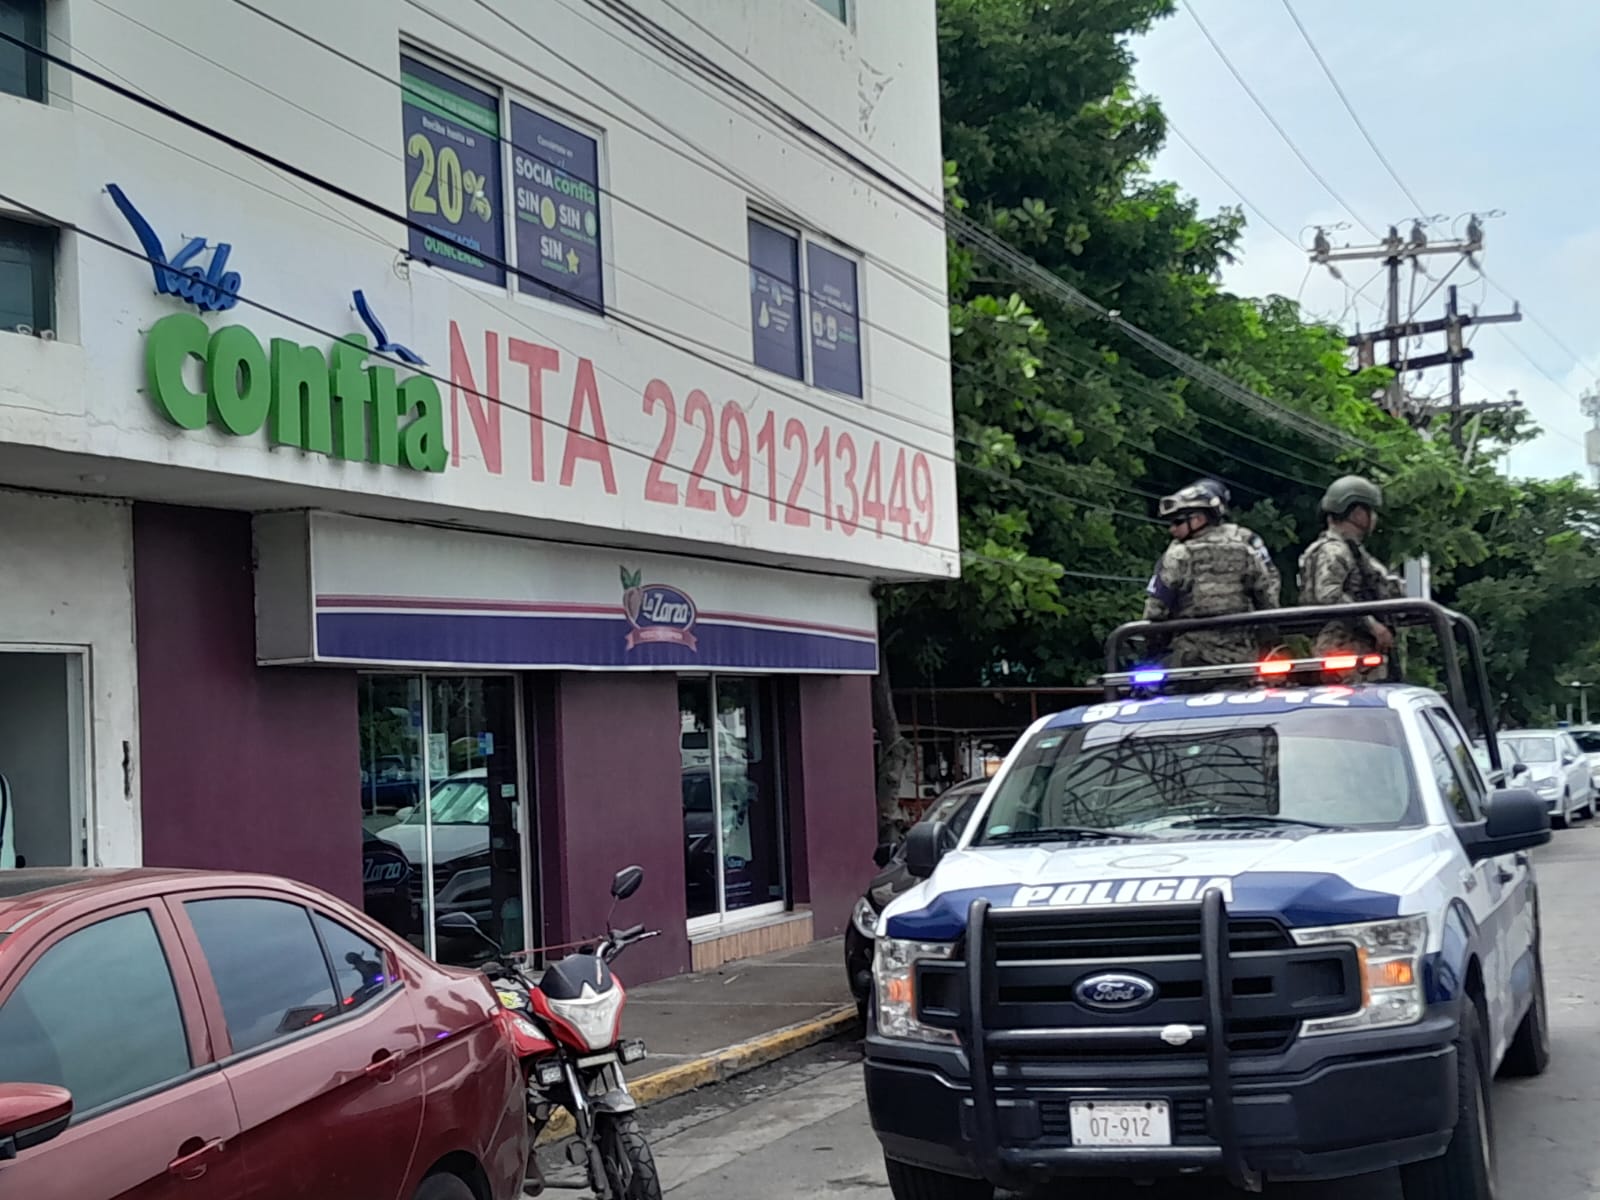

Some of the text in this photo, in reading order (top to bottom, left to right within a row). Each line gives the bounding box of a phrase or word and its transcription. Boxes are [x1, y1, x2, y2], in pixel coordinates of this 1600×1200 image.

[407, 133, 492, 224] 20%
[517, 186, 541, 215] SIN
[559, 203, 581, 232] SIN
[105, 182, 242, 313] Vale
[540, 235, 563, 262] SIN
[642, 378, 934, 546] 2291213449
[652, 593, 689, 624] Zarza
[1011, 877, 1234, 908] POLICIA
[1093, 981, 1135, 1001] Ford
[1090, 1116, 1151, 1137] 07-912
